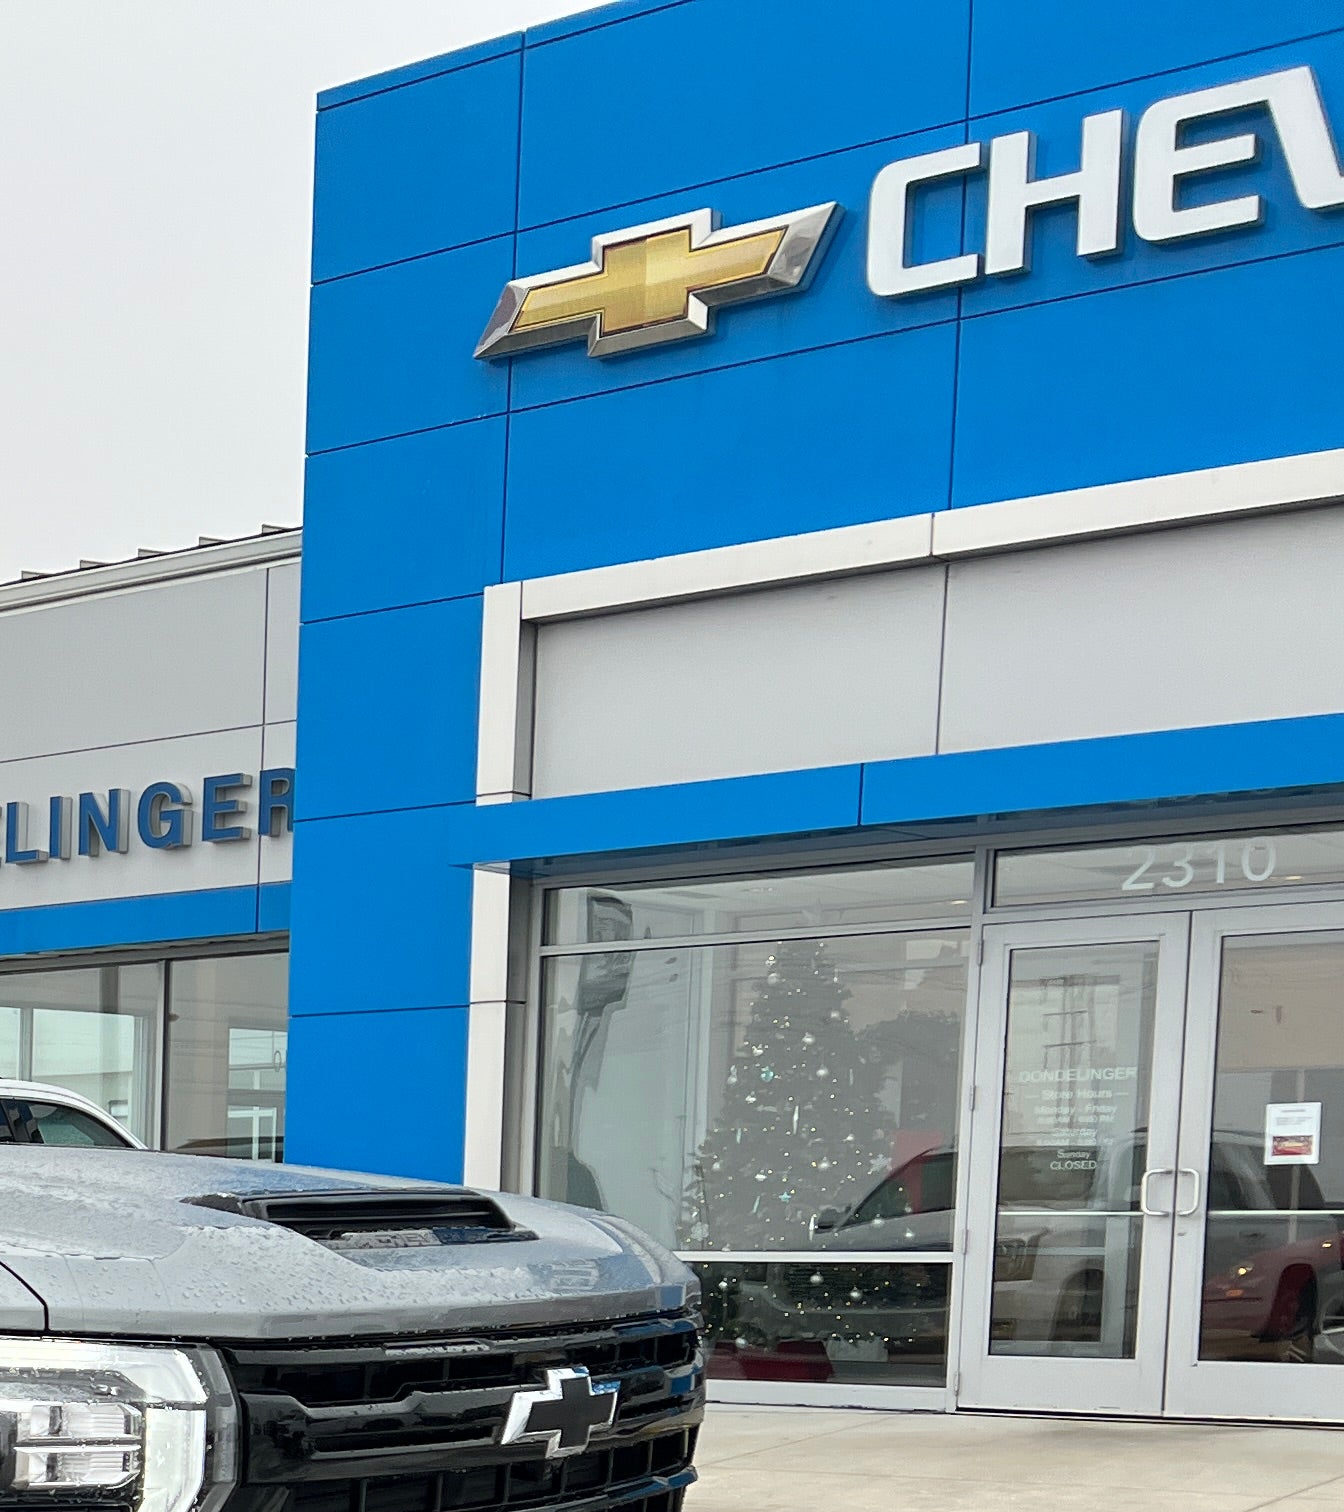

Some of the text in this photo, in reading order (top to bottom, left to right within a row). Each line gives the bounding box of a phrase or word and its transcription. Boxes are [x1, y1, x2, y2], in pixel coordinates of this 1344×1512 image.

[1122, 836, 1276, 891] 2310
[1018, 1066, 1137, 1082] DONDELINGER
[1056, 1149, 1090, 1160] Sunday
[1050, 1160, 1097, 1170] CLOSED
